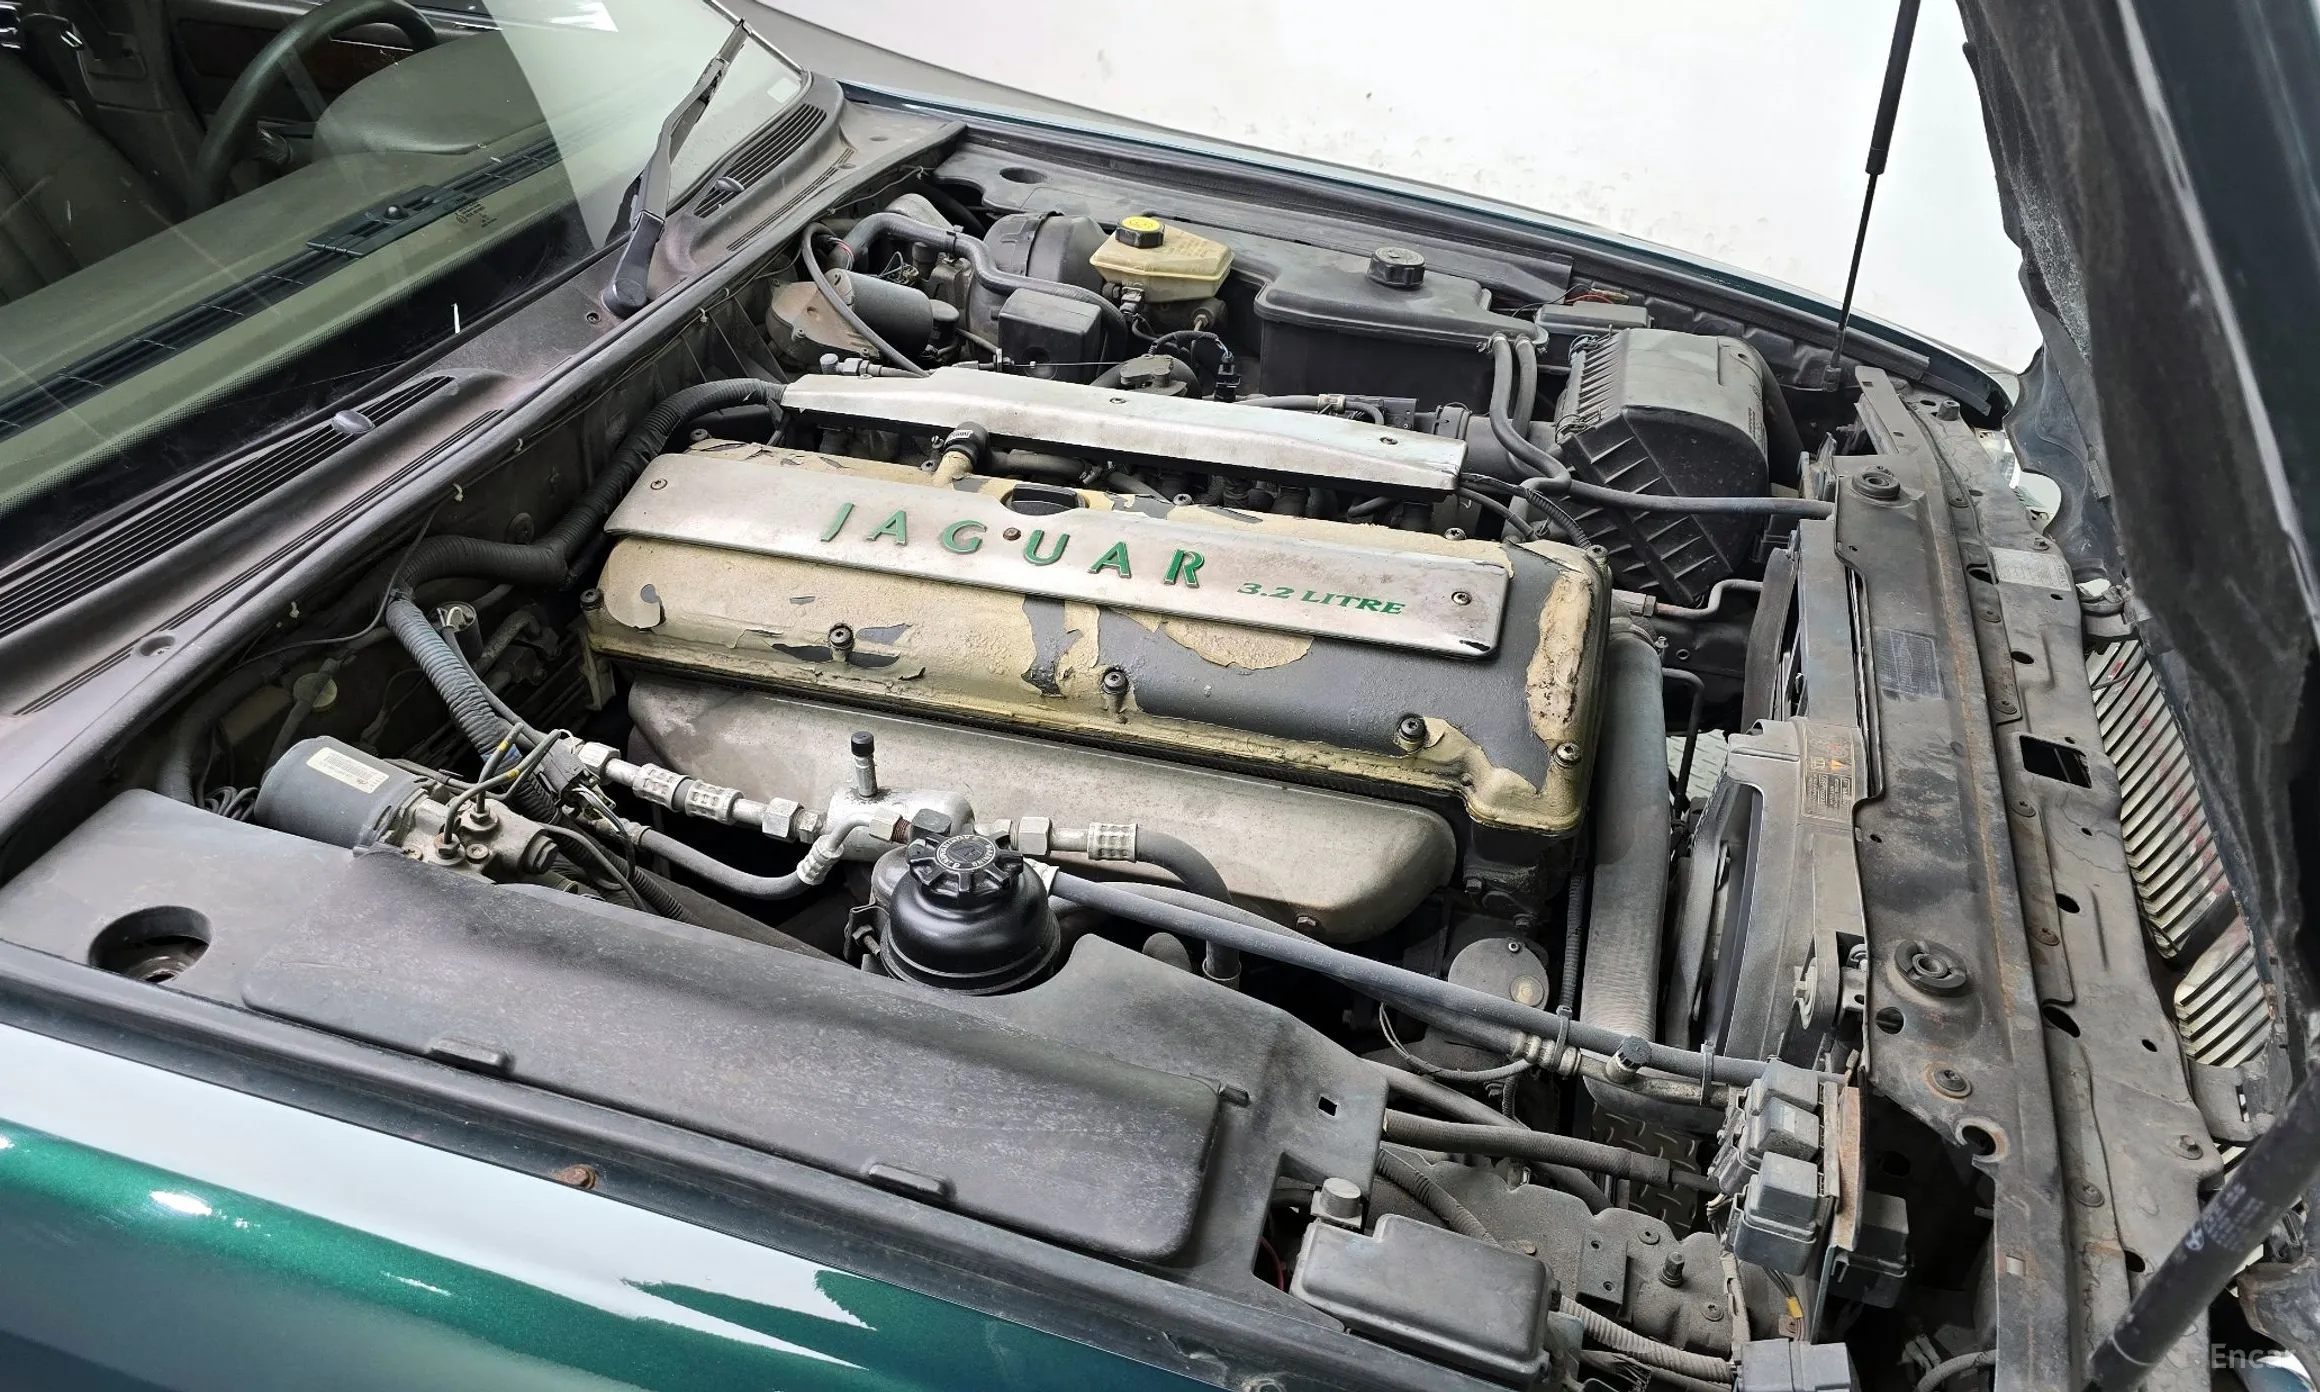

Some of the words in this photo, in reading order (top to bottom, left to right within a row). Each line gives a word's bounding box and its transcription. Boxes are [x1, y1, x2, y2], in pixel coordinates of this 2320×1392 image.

[820, 502, 1204, 588] JAGUAR
[1237, 583, 1294, 599] 3.2
[1300, 590, 1405, 615] LITRE
